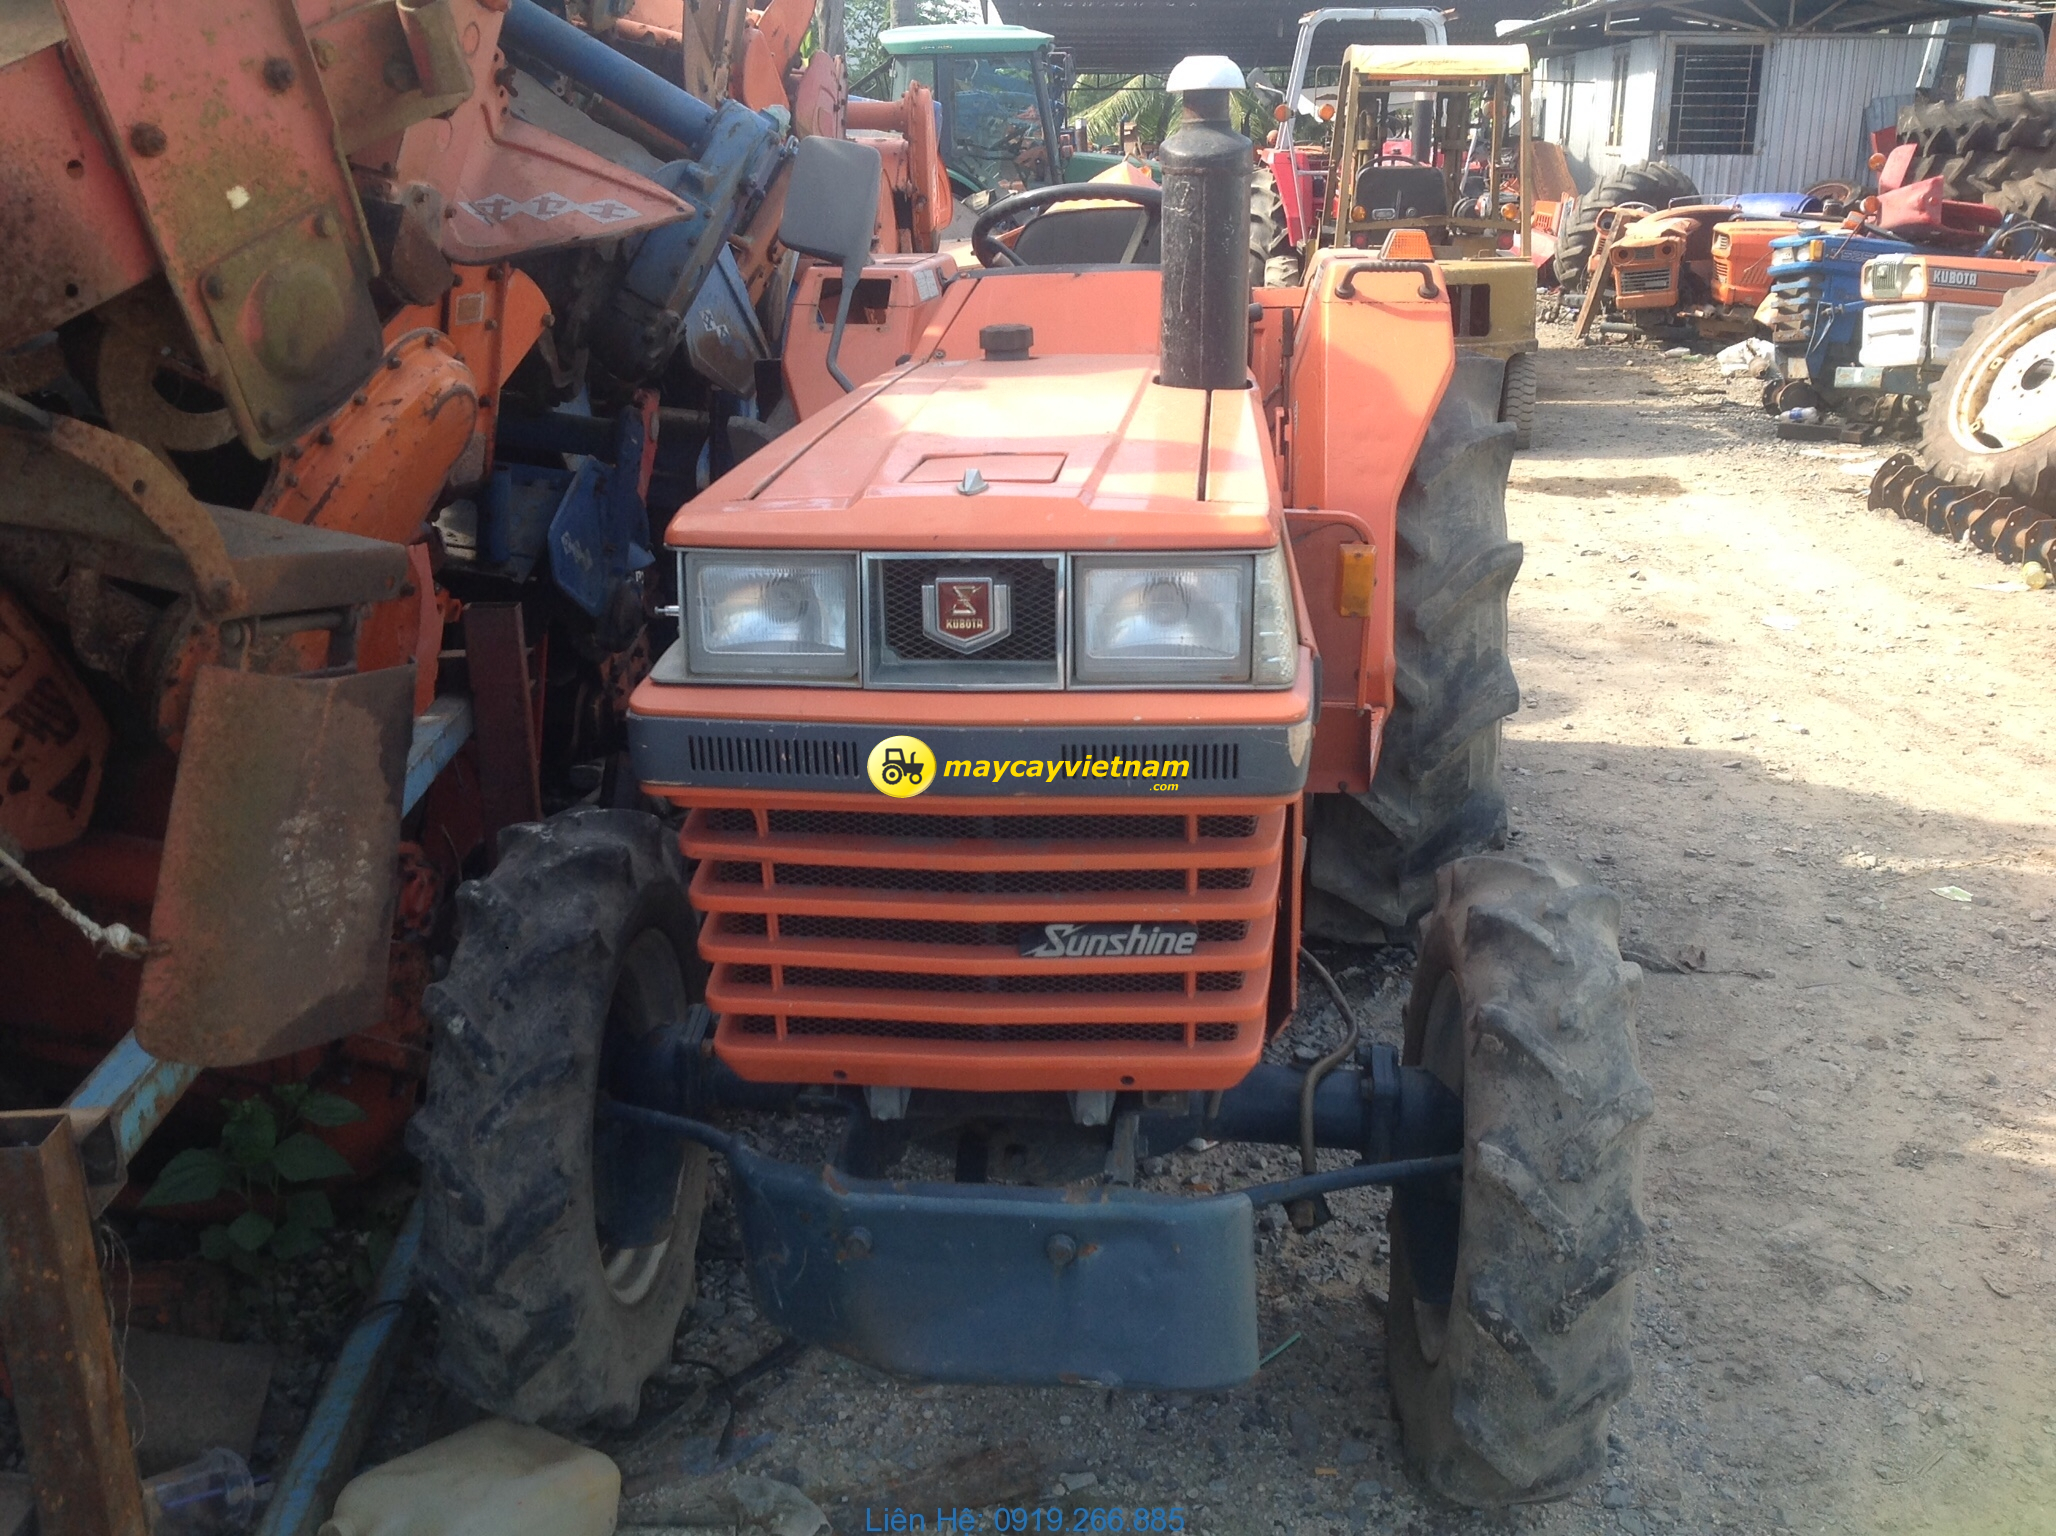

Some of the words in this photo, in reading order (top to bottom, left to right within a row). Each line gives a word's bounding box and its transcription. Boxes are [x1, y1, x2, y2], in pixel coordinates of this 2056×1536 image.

[1933, 269, 1978, 286] KUBOTA
[945, 618, 984, 630] KUBOTA
[1020, 924, 1199, 958] Sunshine
